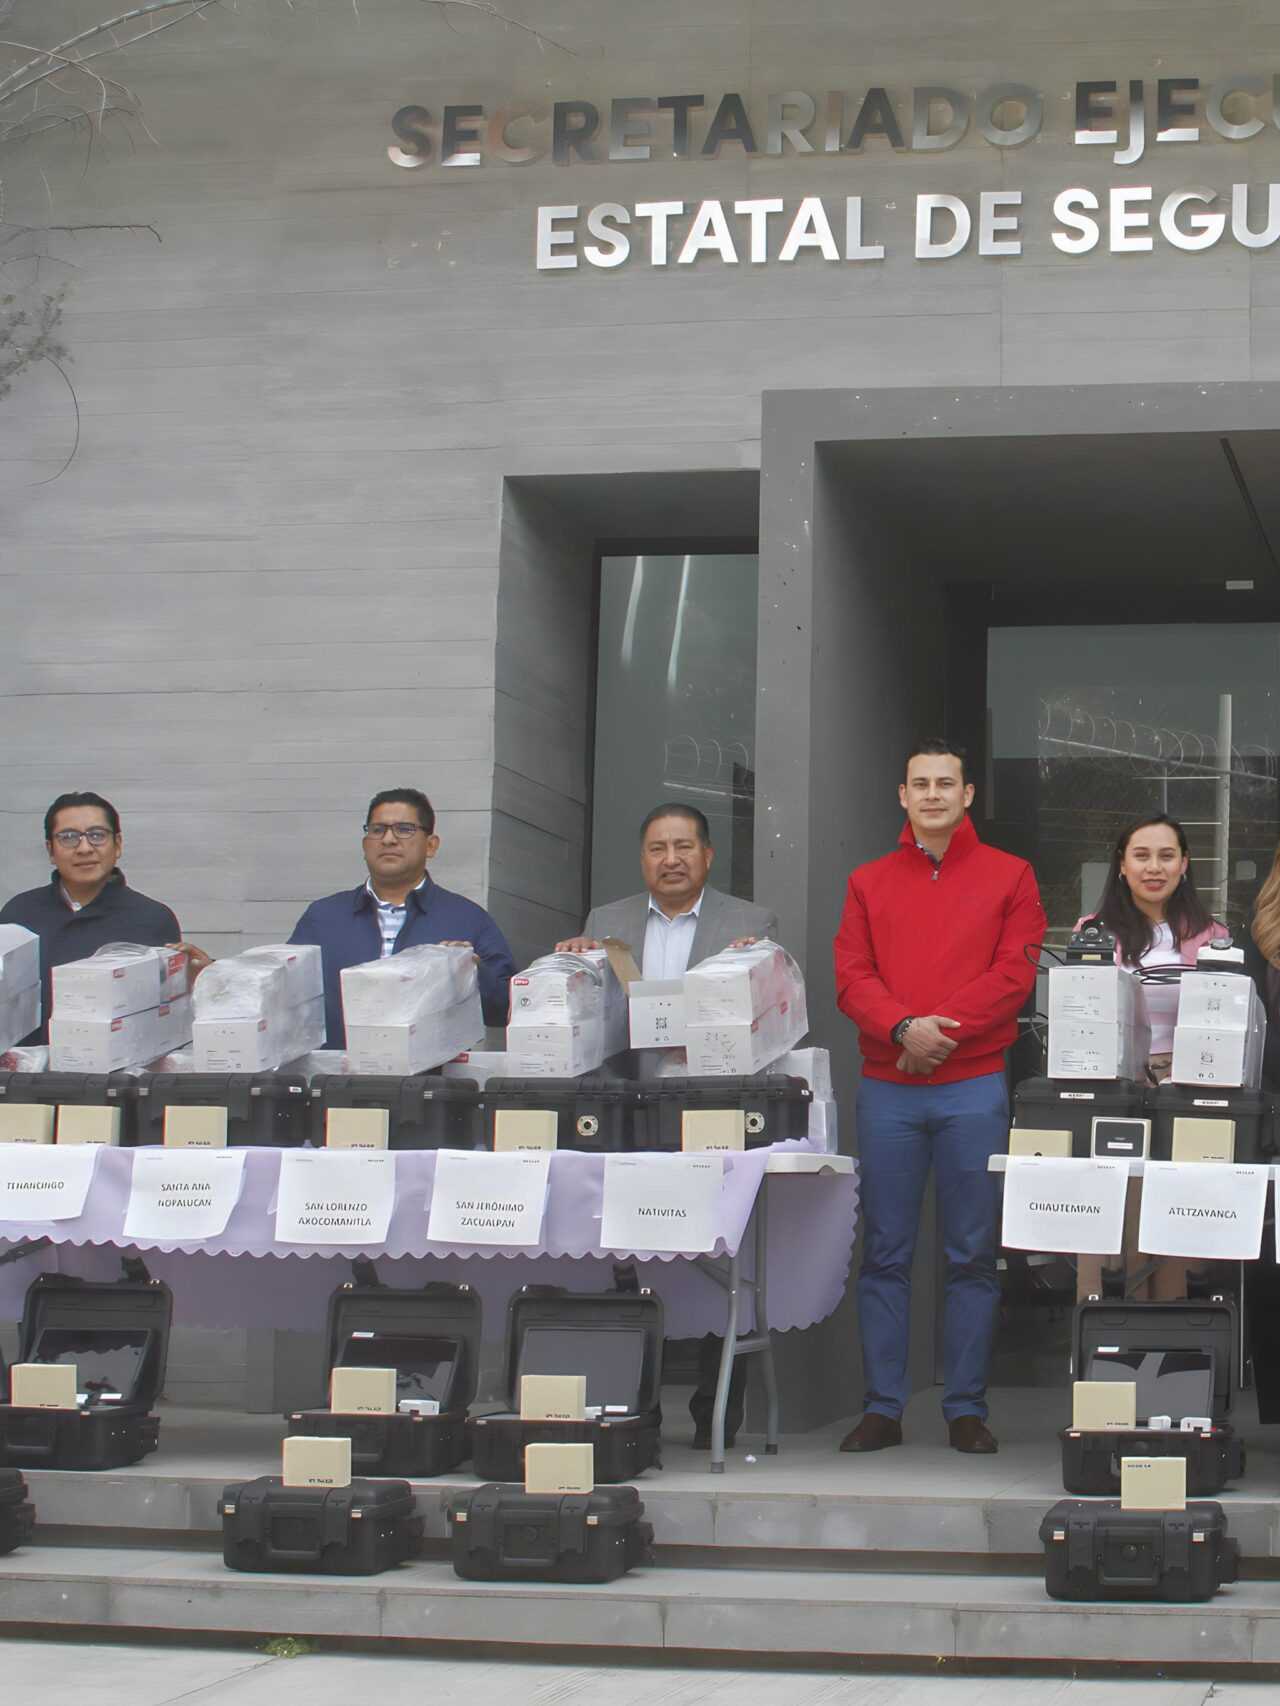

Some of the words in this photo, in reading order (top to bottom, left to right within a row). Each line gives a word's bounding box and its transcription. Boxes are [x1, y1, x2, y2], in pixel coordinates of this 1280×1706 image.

[387, 84, 1044, 168] SECRETARIADO
[536, 197, 884, 270] ESTATAL
[916, 191, 1022, 257] DE
[160, 1183, 190, 1192] SANTA
[191, 1183, 211, 1191] ANA
[157, 1198, 212, 1209] NOPALUCAN
[304, 1202, 324, 1211] SAN
[325, 1202, 368, 1212] LORENZO
[455, 1200, 475, 1209] SAN
[1028, 1201, 1101, 1214] CHIAUTEMPAN
[638, 1207, 687, 1218] NATIVITAS
[460, 1216, 516, 1228] ZACUALPAN
